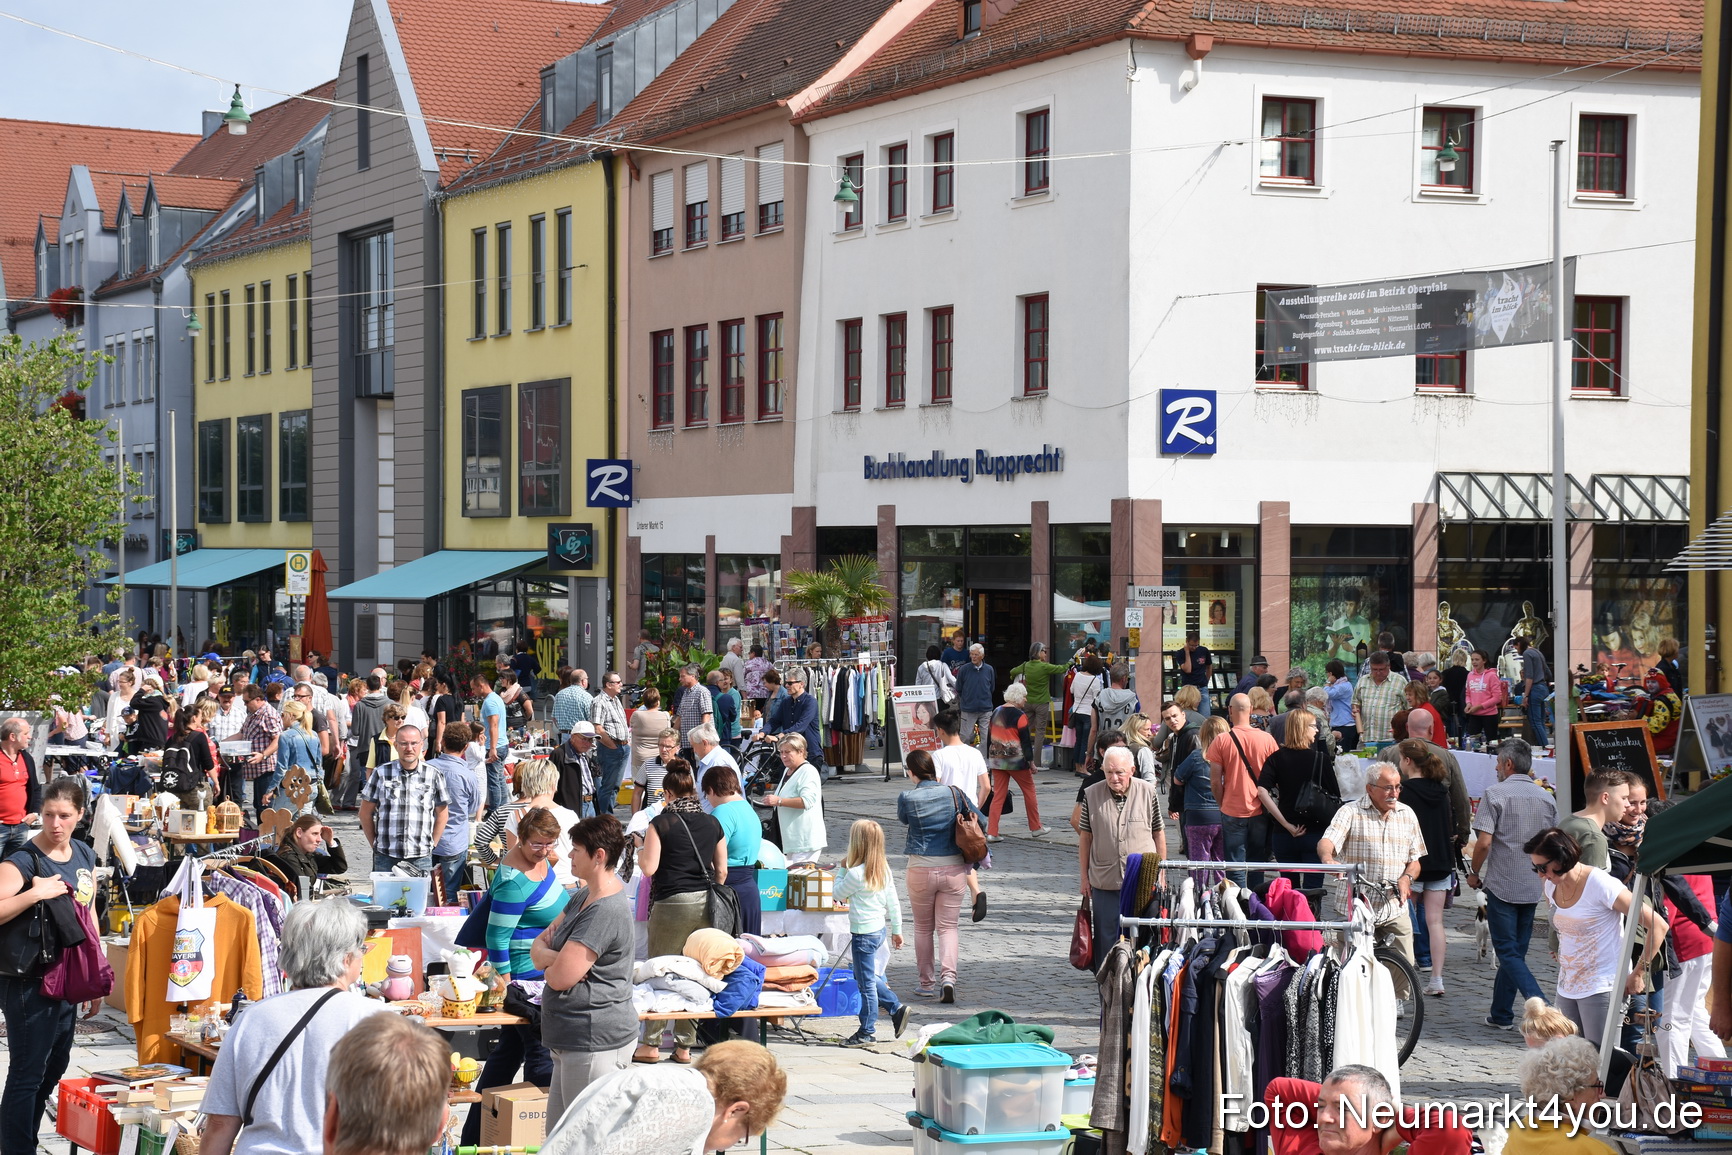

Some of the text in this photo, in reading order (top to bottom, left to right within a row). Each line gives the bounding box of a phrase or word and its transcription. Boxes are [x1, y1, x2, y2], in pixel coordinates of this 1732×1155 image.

[1279, 282, 1448, 305] Ausstellungsreihe 2016 im Bezirk Oberpfalz
[1497, 295, 1519, 304] tracht
[1373, 305, 1400, 313] Neukirchen
[1502, 302, 1519, 311] blick
[1346, 308, 1365, 316] Weiden
[1314, 320, 1343, 329] Regensburg
[1350, 317, 1379, 325] Schwandorf
[1388, 324, 1413, 332] Neumarkt
[1314, 340, 1406, 354] www.tracht-im-blick.de
[863, 443, 1062, 483] Buchhandlung Rupprecht
[566, 536, 582, 555] G2
[1138, 588, 1176, 599] Klostergasse
[536, 637, 560, 680] SALE
[528, 1111, 540, 1119] BD
